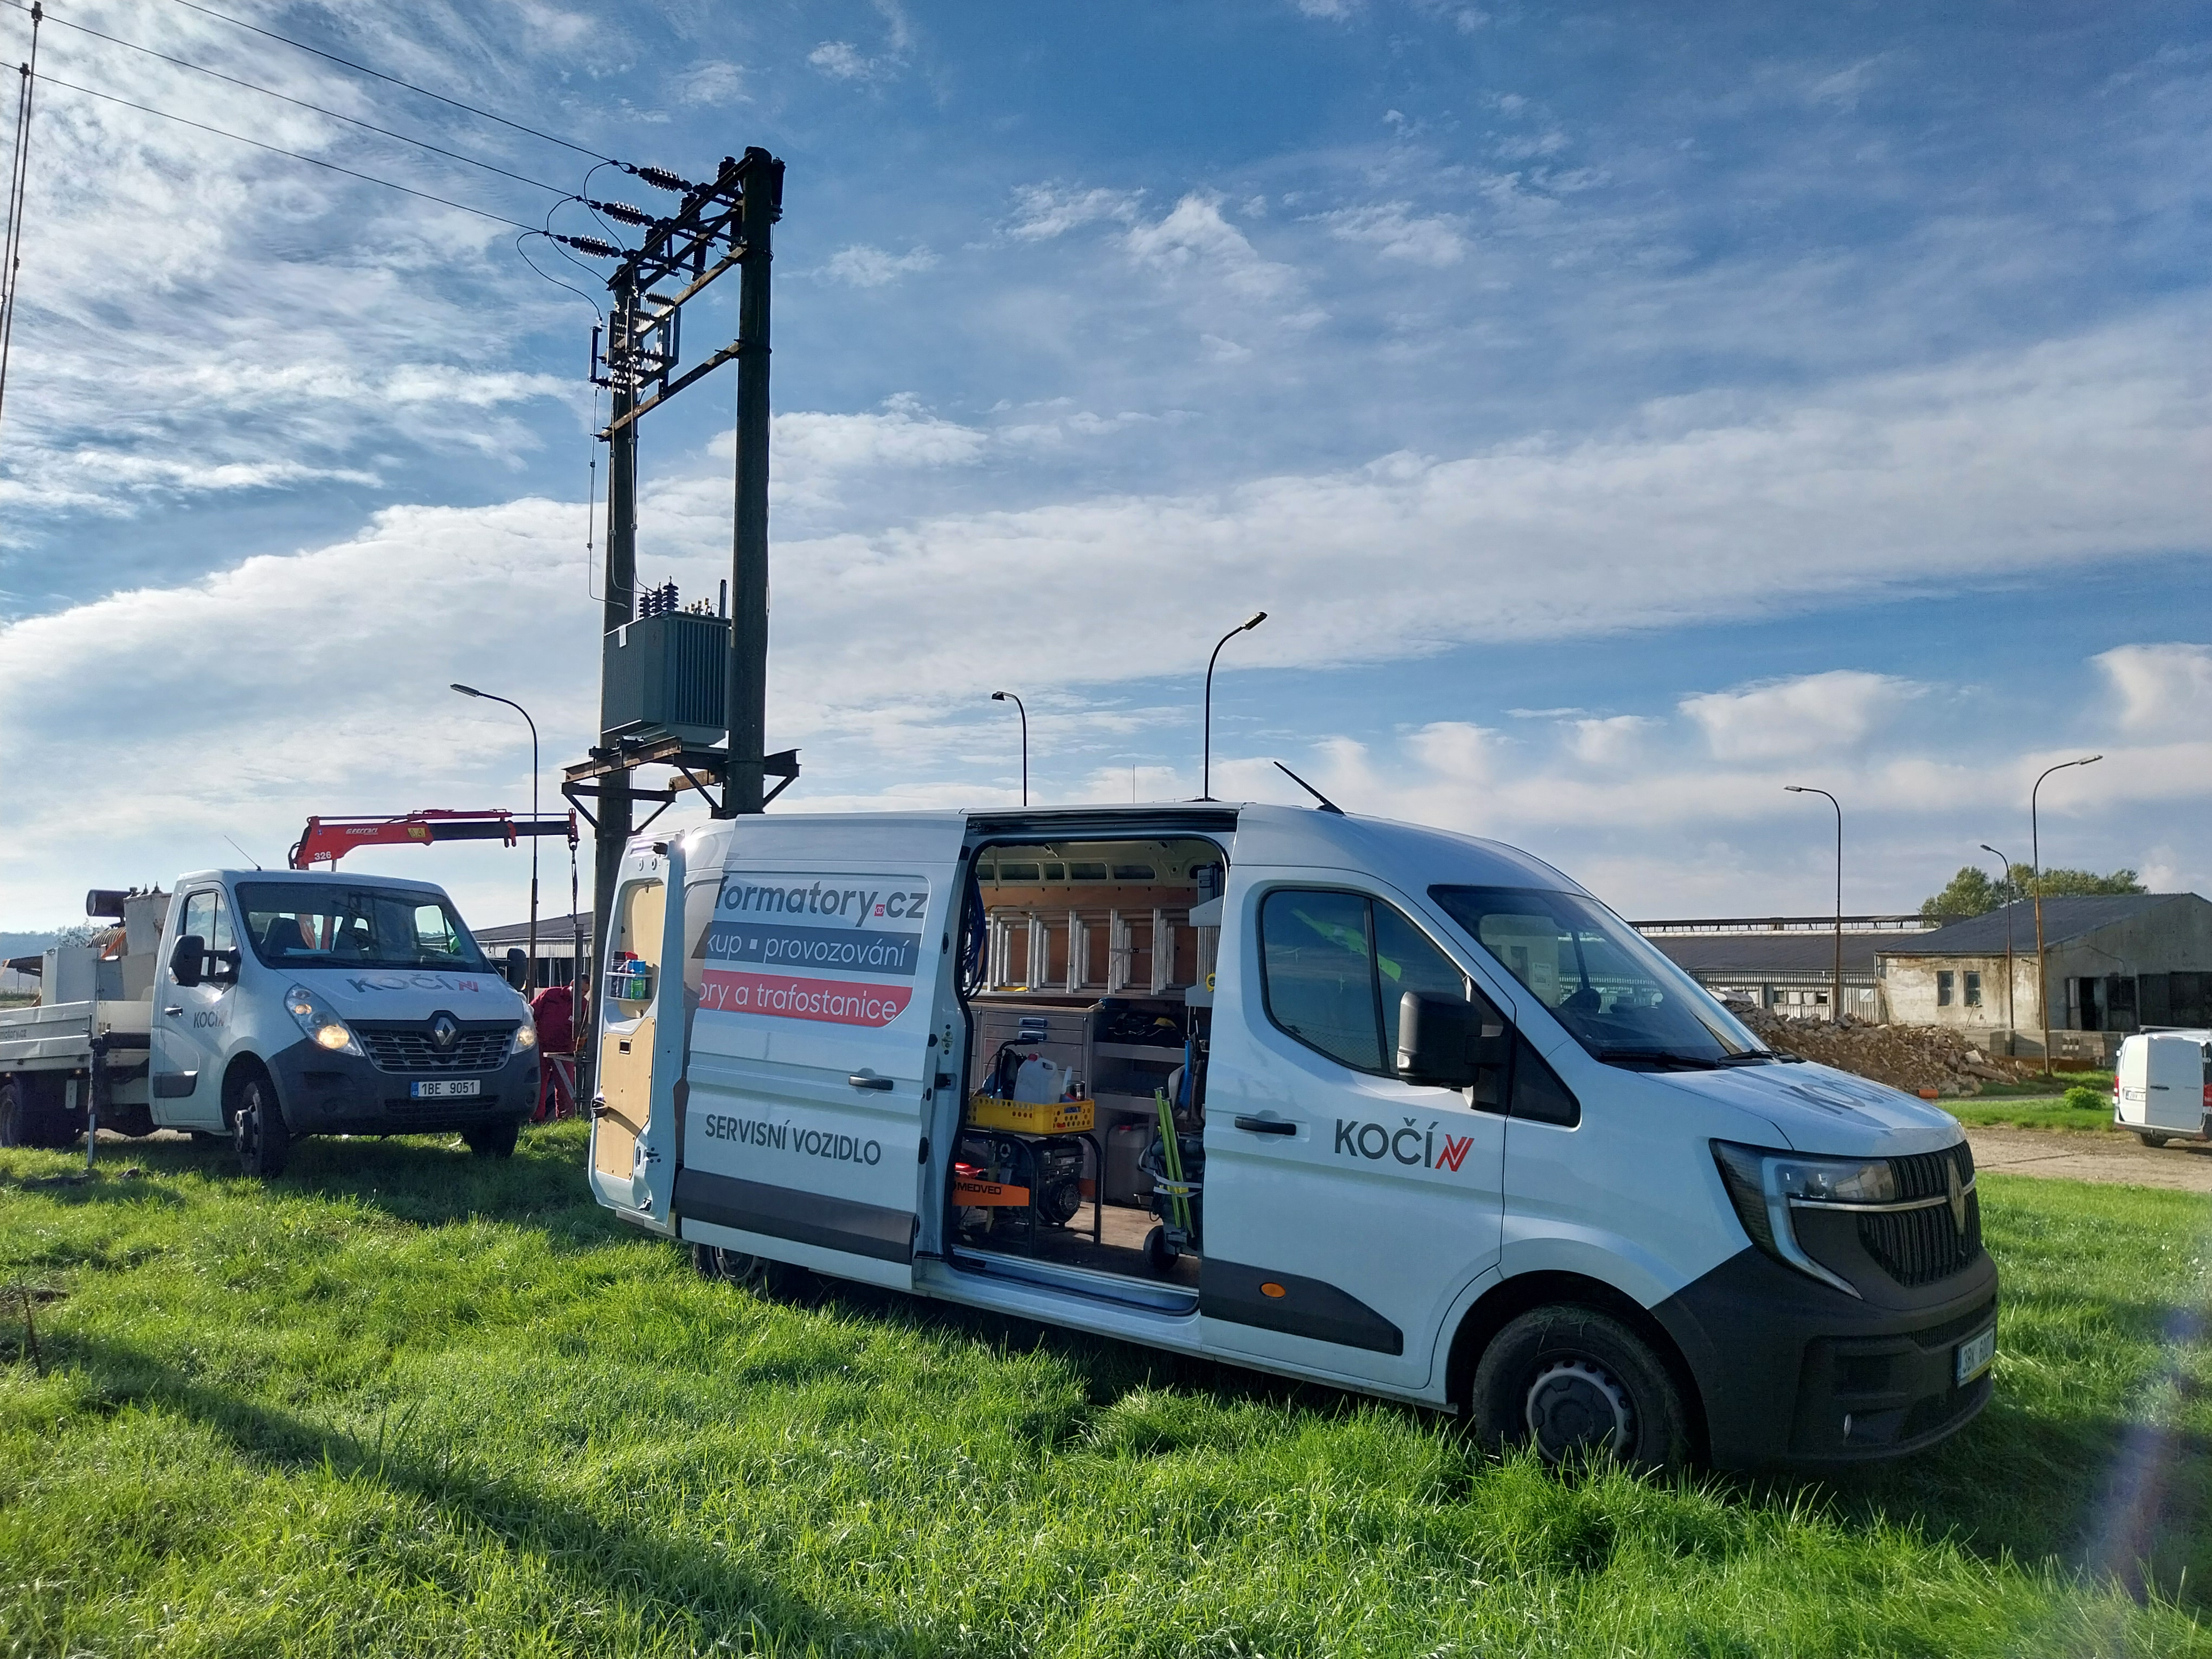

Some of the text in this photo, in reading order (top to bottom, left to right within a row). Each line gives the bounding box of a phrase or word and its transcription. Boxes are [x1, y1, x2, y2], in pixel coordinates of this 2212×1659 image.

[314, 851, 332, 860] 326
[763, 937, 910, 967] provozování
[735, 986, 749, 1006] a
[757, 983, 897, 1021] trafostanice
[422, 1083, 441, 1095] 1BE
[449, 1082, 475, 1094] 9051
[705, 1114, 881, 1166] SERVISNÍ VOZIDLO
[957, 1182, 1001, 1195] MEDVED
